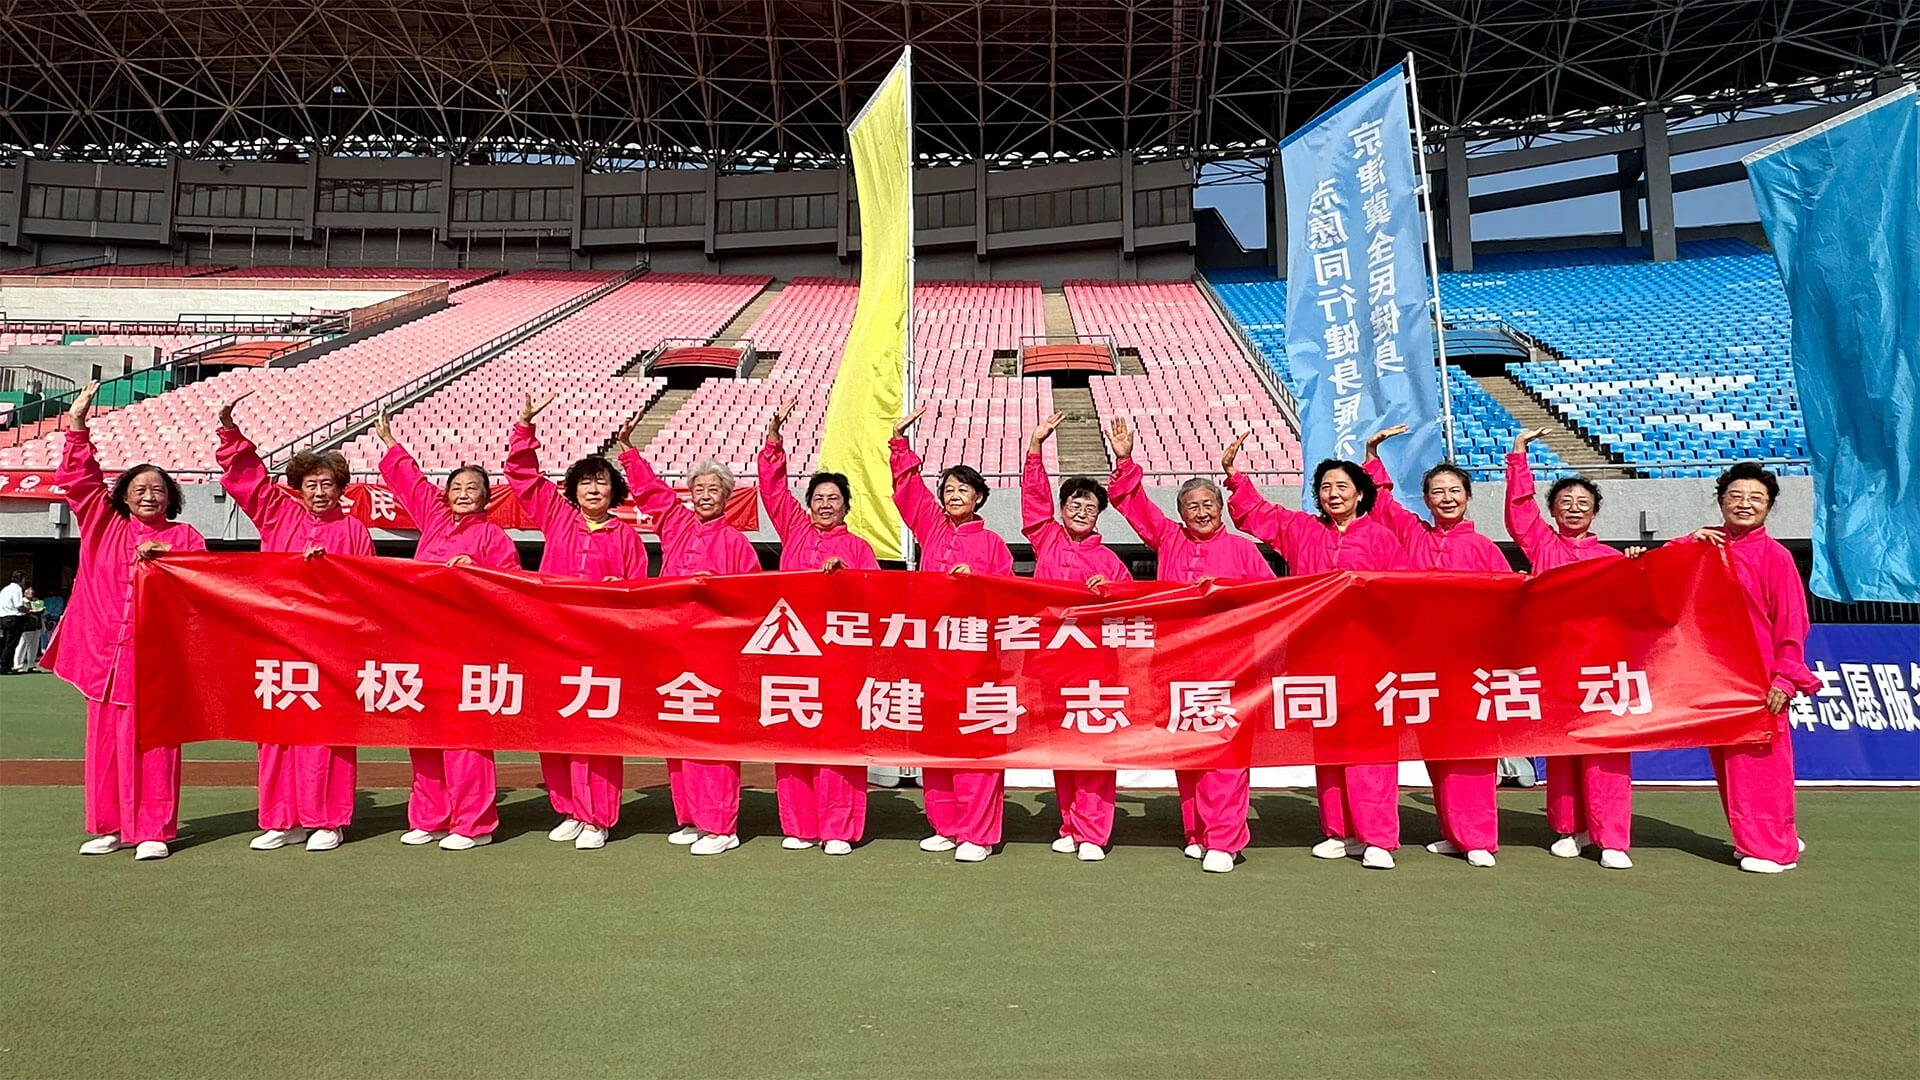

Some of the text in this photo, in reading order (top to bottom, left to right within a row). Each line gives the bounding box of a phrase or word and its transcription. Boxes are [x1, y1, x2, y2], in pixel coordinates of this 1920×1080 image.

[821, 610, 1157, 652] 足力健老人鞋
[254, 659, 1654, 735] 积极助力全民健身志愿同行活动
[1789, 660, 1920, 732] 志愿服
